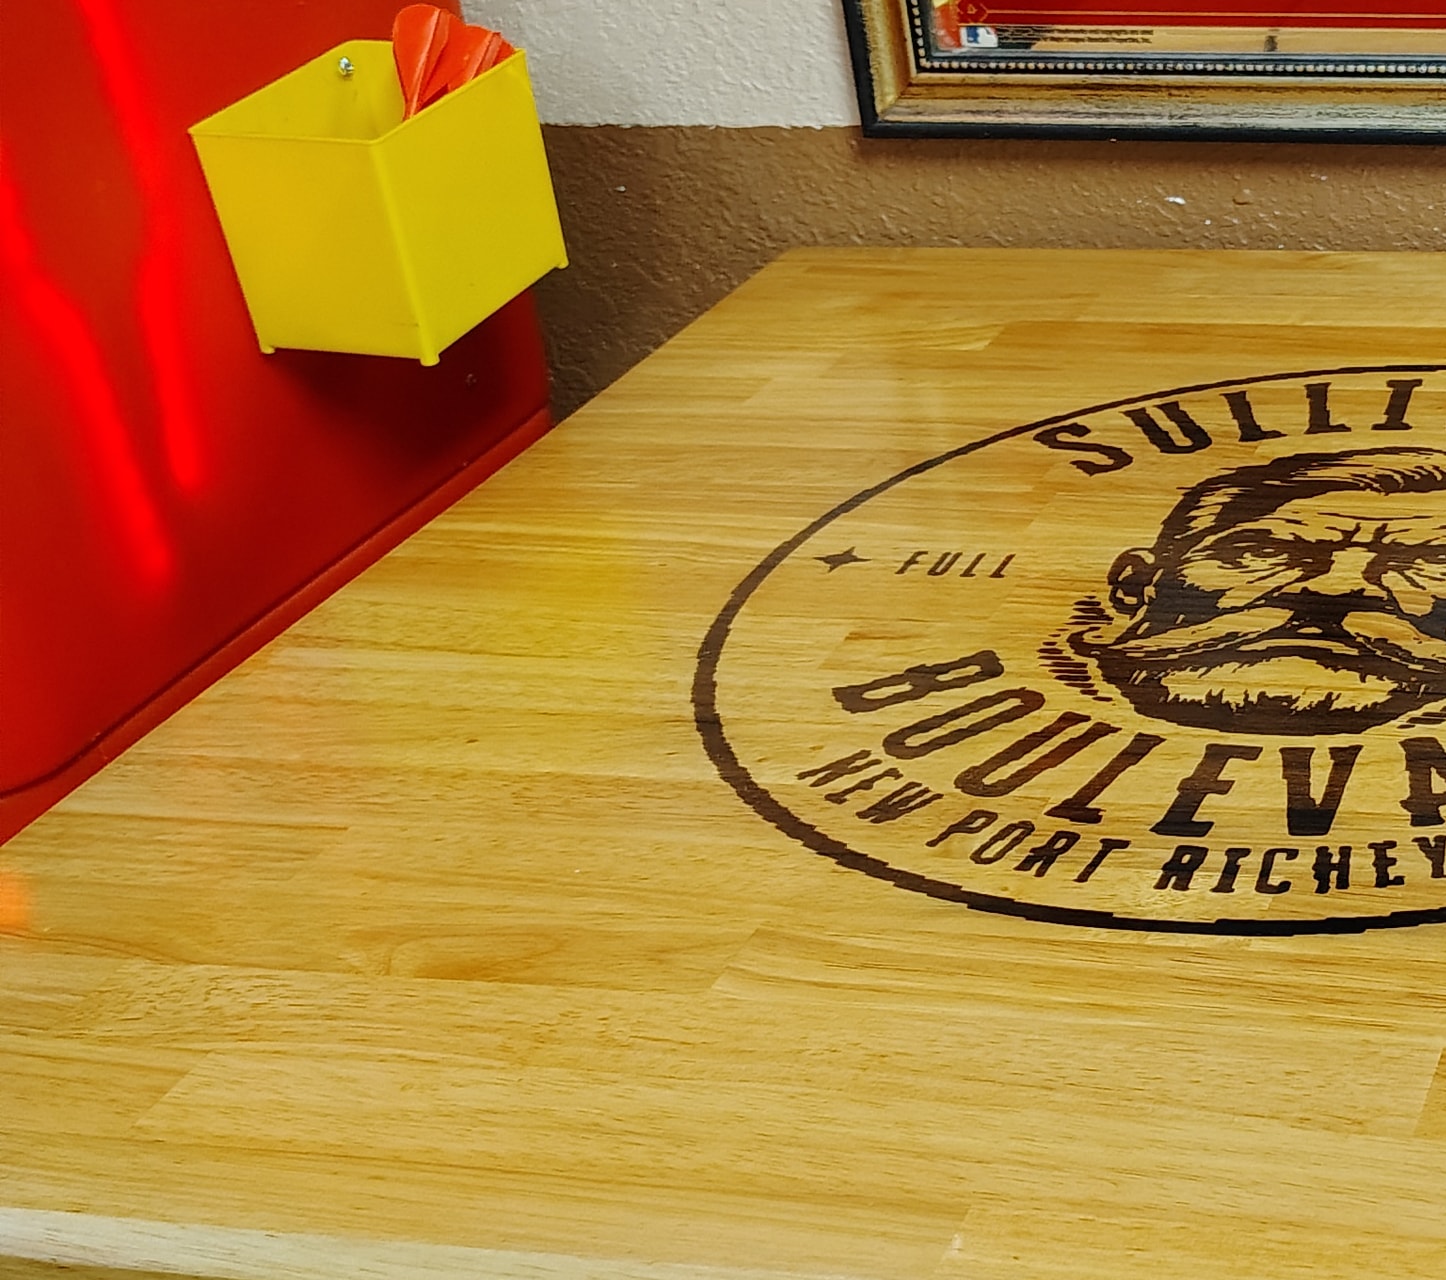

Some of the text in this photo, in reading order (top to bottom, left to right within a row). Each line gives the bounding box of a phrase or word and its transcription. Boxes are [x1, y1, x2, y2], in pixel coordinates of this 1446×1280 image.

[895, 551, 1016, 580] FULL
[796, 748, 943, 825] NEW
[926, 809, 1130, 883] PORT
